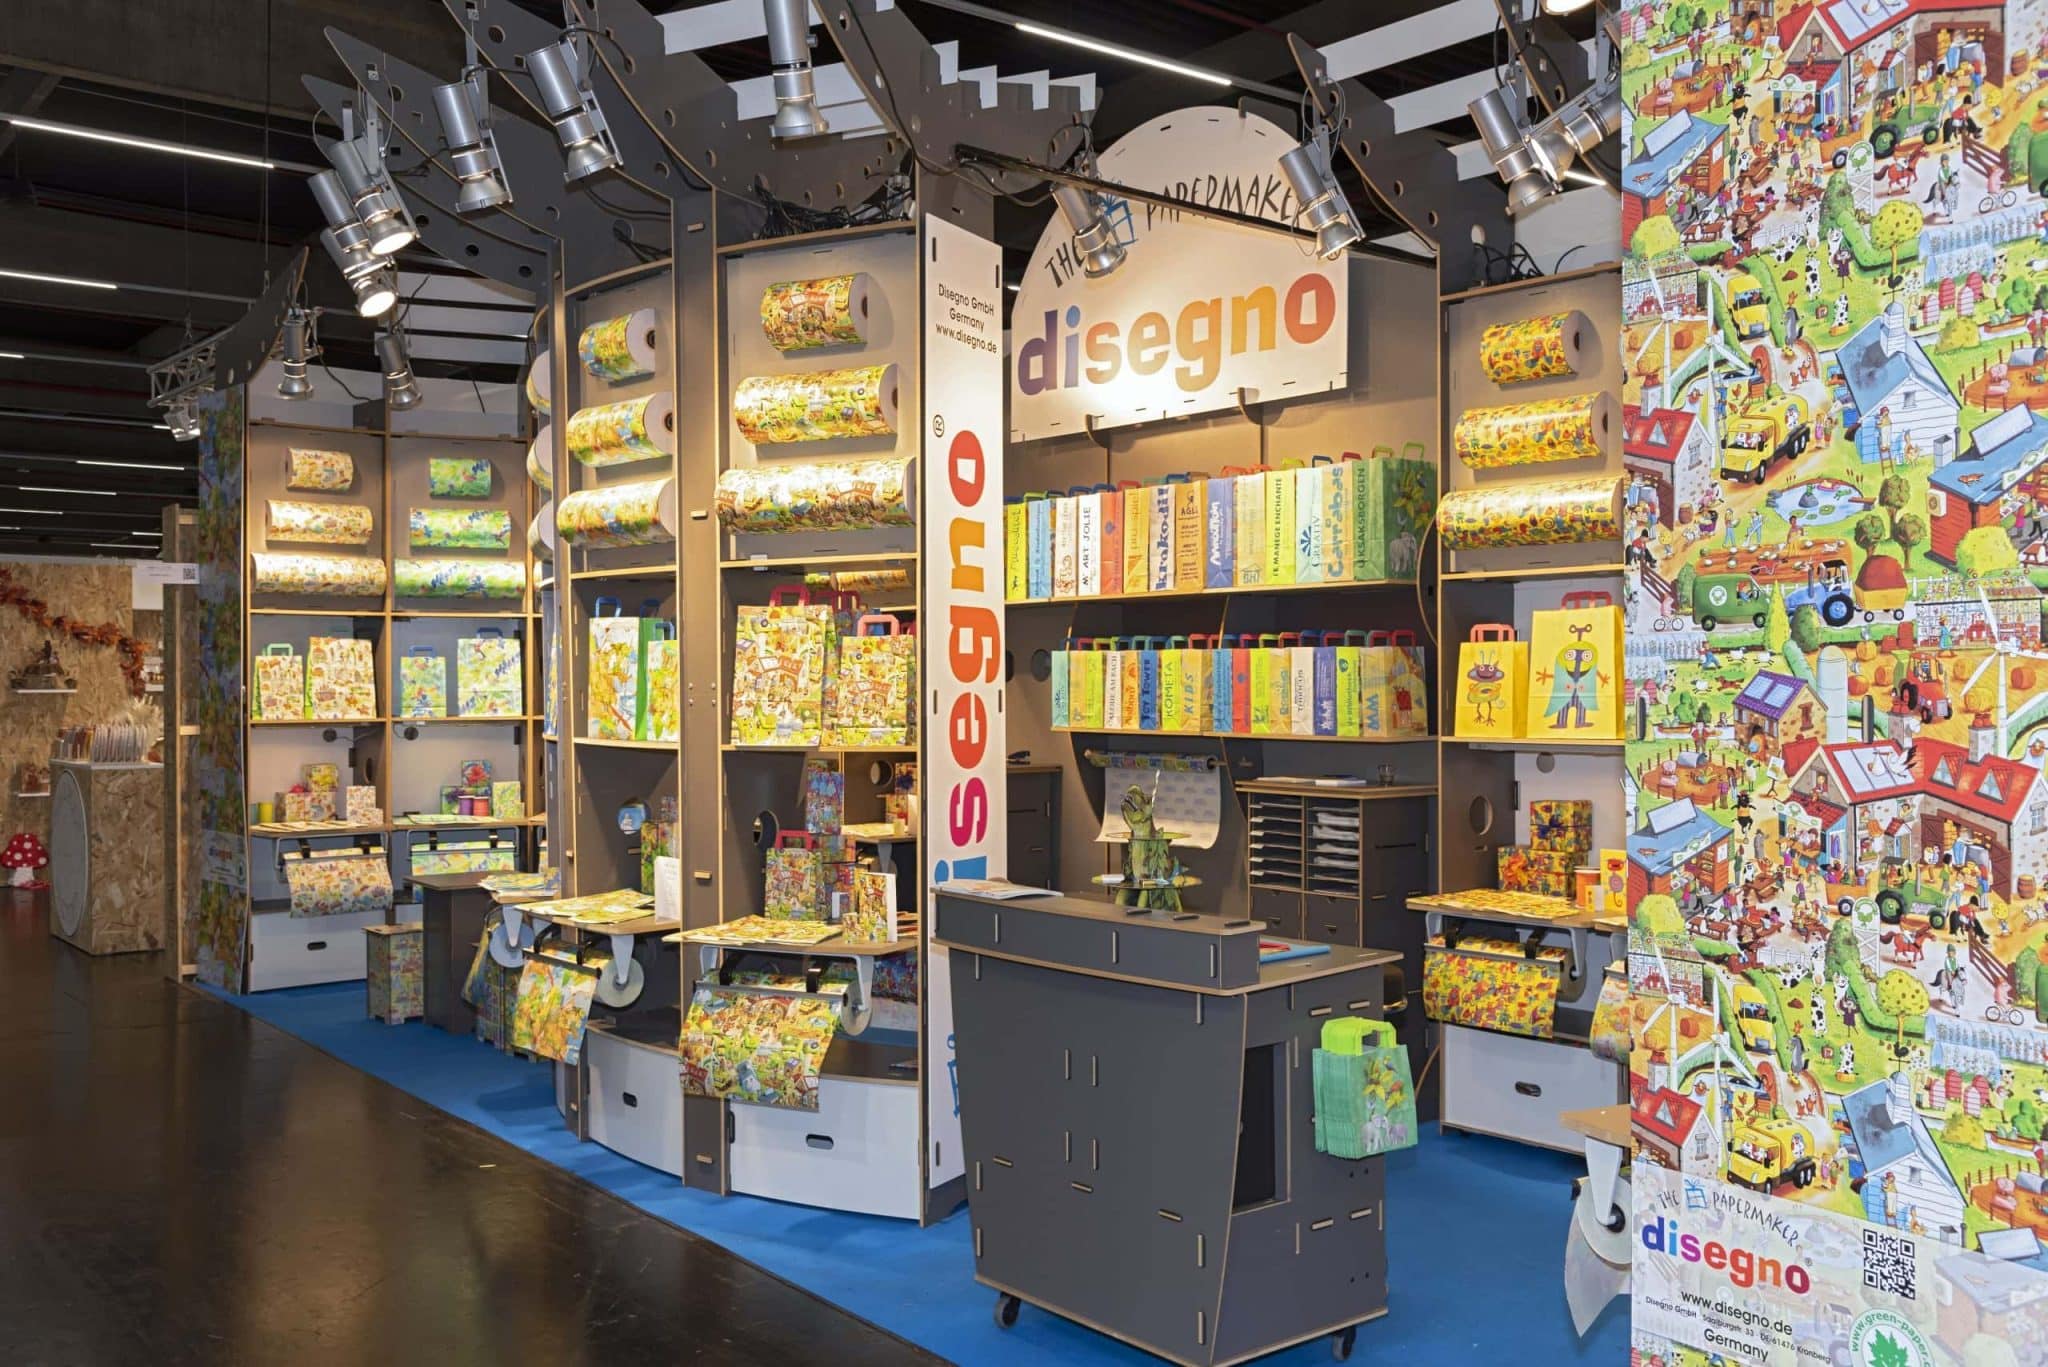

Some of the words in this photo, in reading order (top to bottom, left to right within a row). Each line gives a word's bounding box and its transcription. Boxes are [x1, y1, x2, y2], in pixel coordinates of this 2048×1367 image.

[938, 282, 970, 306] Disegno
[971, 296, 995, 316] GmbH
[949, 307, 985, 334] Germany
[935, 322, 997, 354] www.disegno.de
[1018, 273, 1336, 396] disegno
[1083, 506, 1091, 542] JOLIE
[1155, 487, 1169, 590] krokodil
[1327, 466, 1344, 577] Carrabas
[1082, 547, 1090, 569] ART
[934, 429, 1001, 885] isegno
[1164, 662, 1174, 717] KOMETA
[1184, 672, 1194, 715] KIDS
[1657, 1190, 1680, 1209] THE
[1712, 1190, 1799, 1248] PAPERMAKER
[1641, 1215, 1810, 1295] disegno
[1645, 1295, 1673, 1312] Disegno
[1674, 1304, 1697, 1319] GmbH
[1681, 1290, 1793, 1336] www.disegno.de
[1703, 1327, 1769, 1363] Germany
